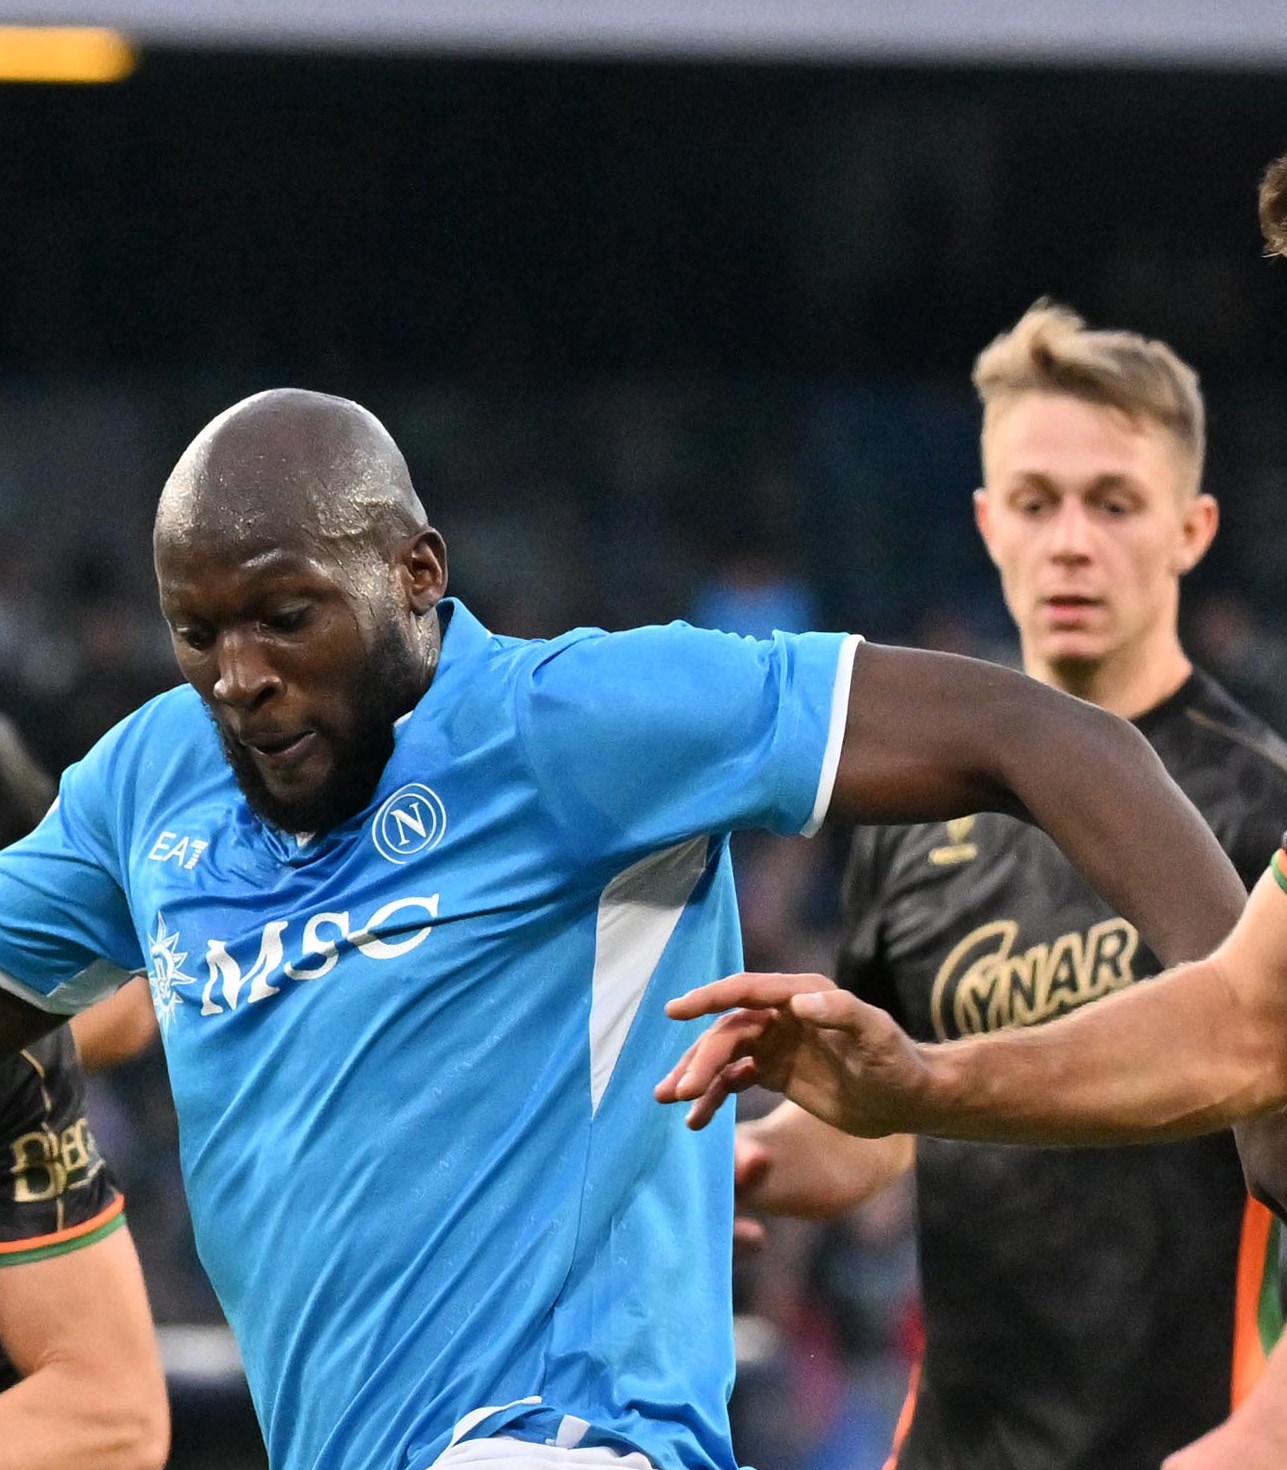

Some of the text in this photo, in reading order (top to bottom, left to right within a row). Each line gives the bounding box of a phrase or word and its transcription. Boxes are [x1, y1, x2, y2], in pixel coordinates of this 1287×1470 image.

[389, 803, 428, 846] N
[149, 832, 208, 870] EA7
[200, 893, 440, 1016] MSC
